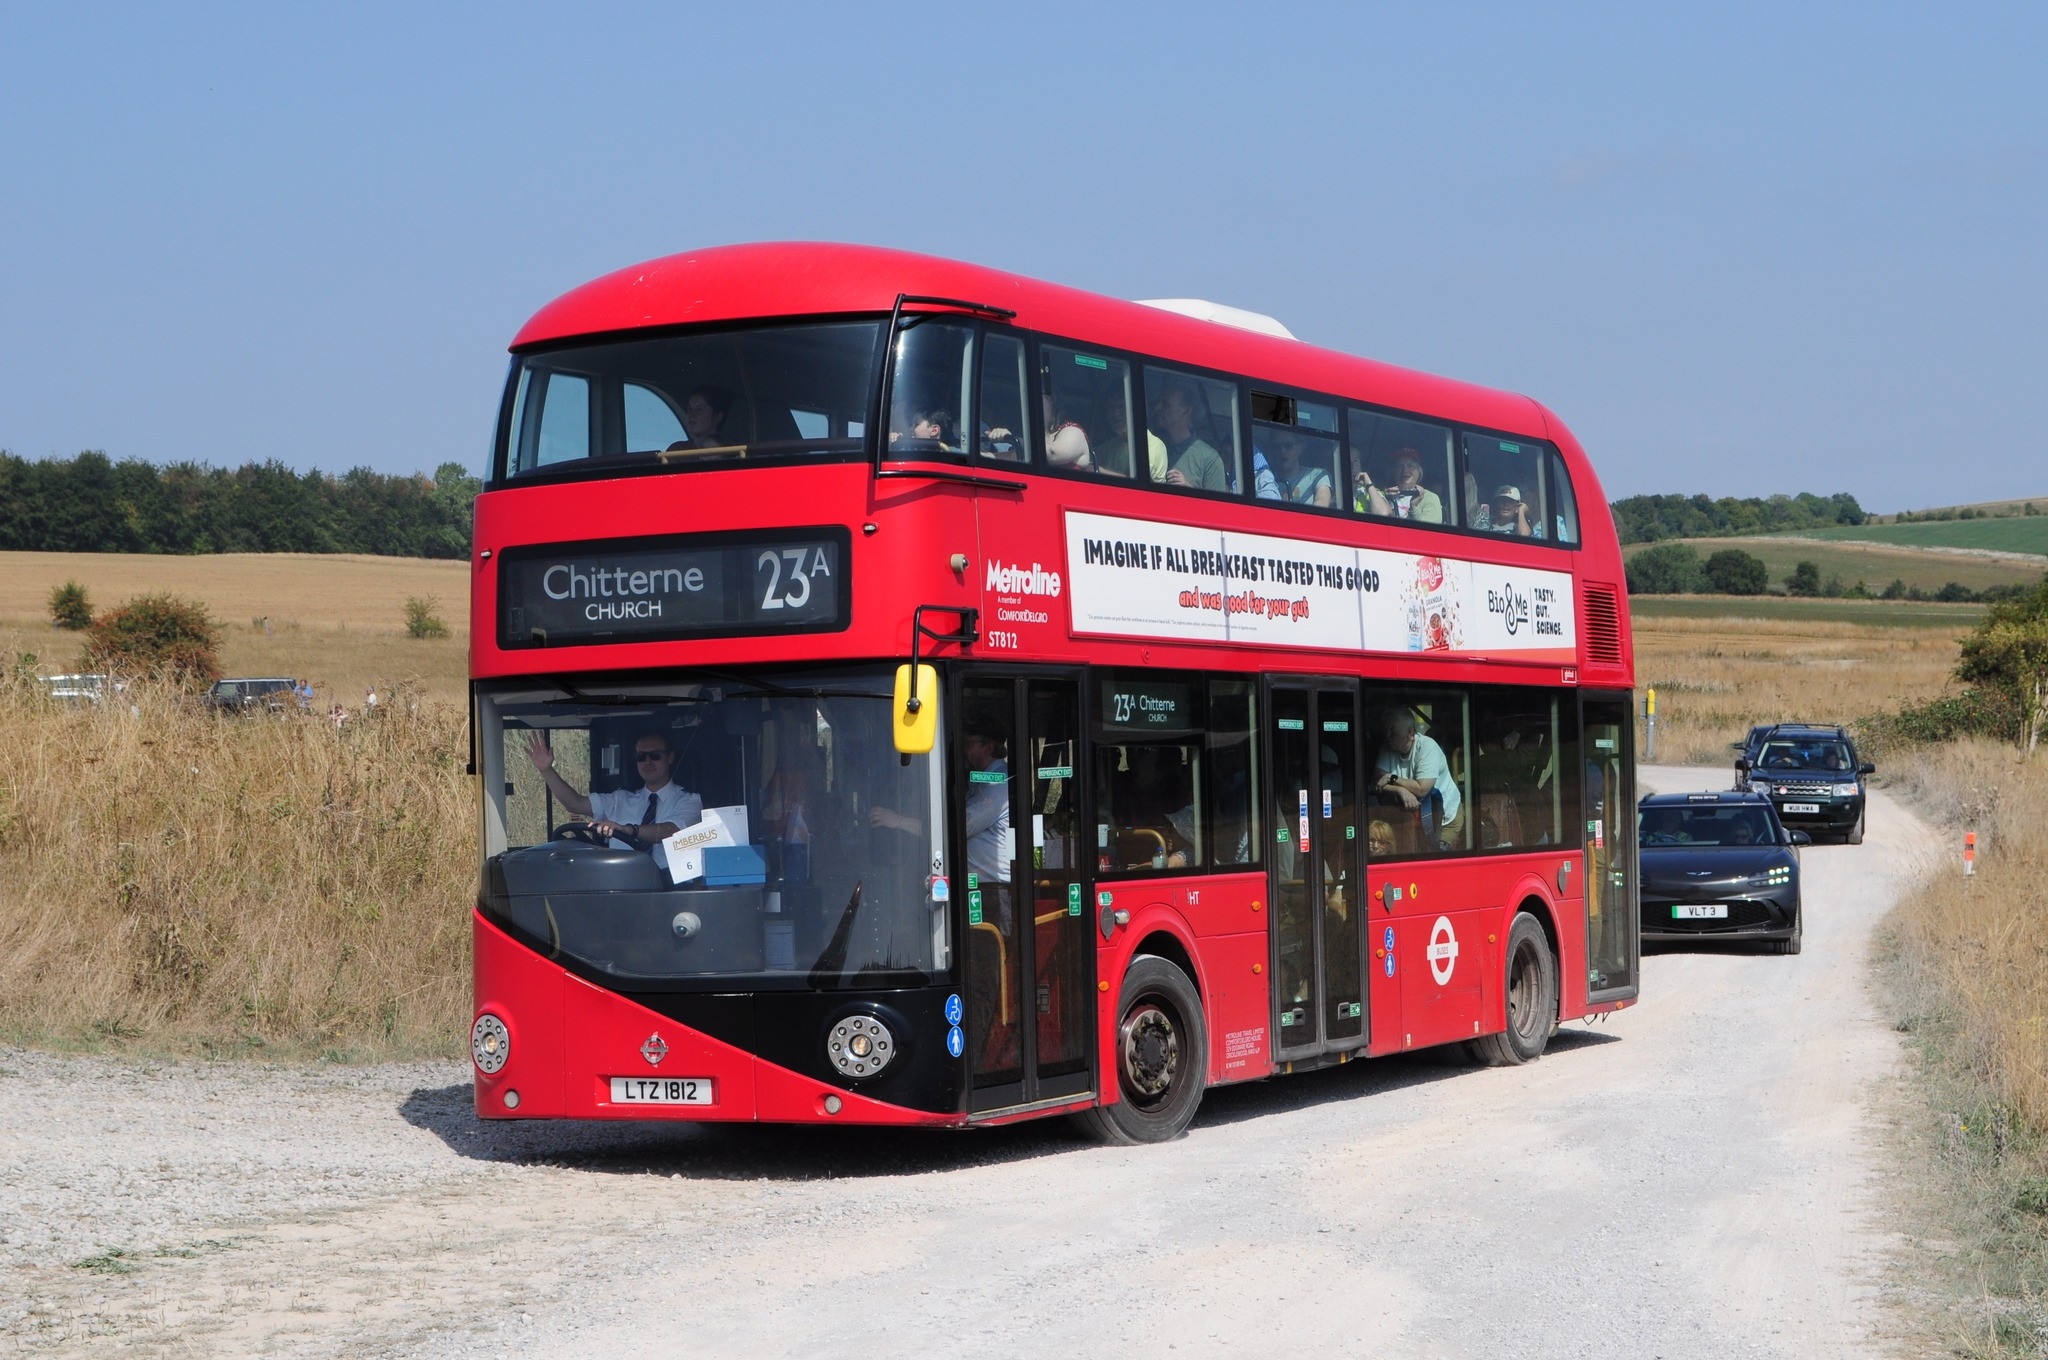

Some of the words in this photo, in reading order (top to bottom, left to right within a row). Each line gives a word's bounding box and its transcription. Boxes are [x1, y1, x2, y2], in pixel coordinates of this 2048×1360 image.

[1083, 538, 1148, 570] IMAGINE
[1150, 545, 1163, 570] IF
[1166, 547, 1189, 574] ALL
[1190, 549, 1265, 582] BREAKFAST
[1268, 559, 1314, 585] TASTED
[1316, 564, 1343, 590] THIS
[1345, 567, 1380, 593] GOOD
[543, 564, 704, 600] Chitterne
[986, 558, 1061, 598] Metroline
[1534, 588, 1556, 602] TASTY.
[585, 600, 662, 621] CHURCH
[1179, 586, 1199, 609] and
[1200, 592, 1222, 611] was
[1223, 591, 1248, 617] good
[1249, 590, 1265, 615] for
[1267, 598, 1290, 620] your
[1291, 596, 1310, 623] gut
[1535, 604, 1550, 618] GUT.
[1536, 621, 1563, 636] SCIENCE.
[989, 631, 1018, 649] ST812
[1139, 695, 1175, 712] Chitterne
[1148, 713, 1168, 722] CHURCH
[672, 829, 718, 851] IMBERBUS
[686, 861, 693, 870] 6
[1189, 890, 1200, 905] HT
[1689, 906, 1707, 916] VLT
[1710, 906, 1716, 916] 3
[625, 1081, 659, 1099] LTZ
[664, 1081, 697, 1100] 1812
